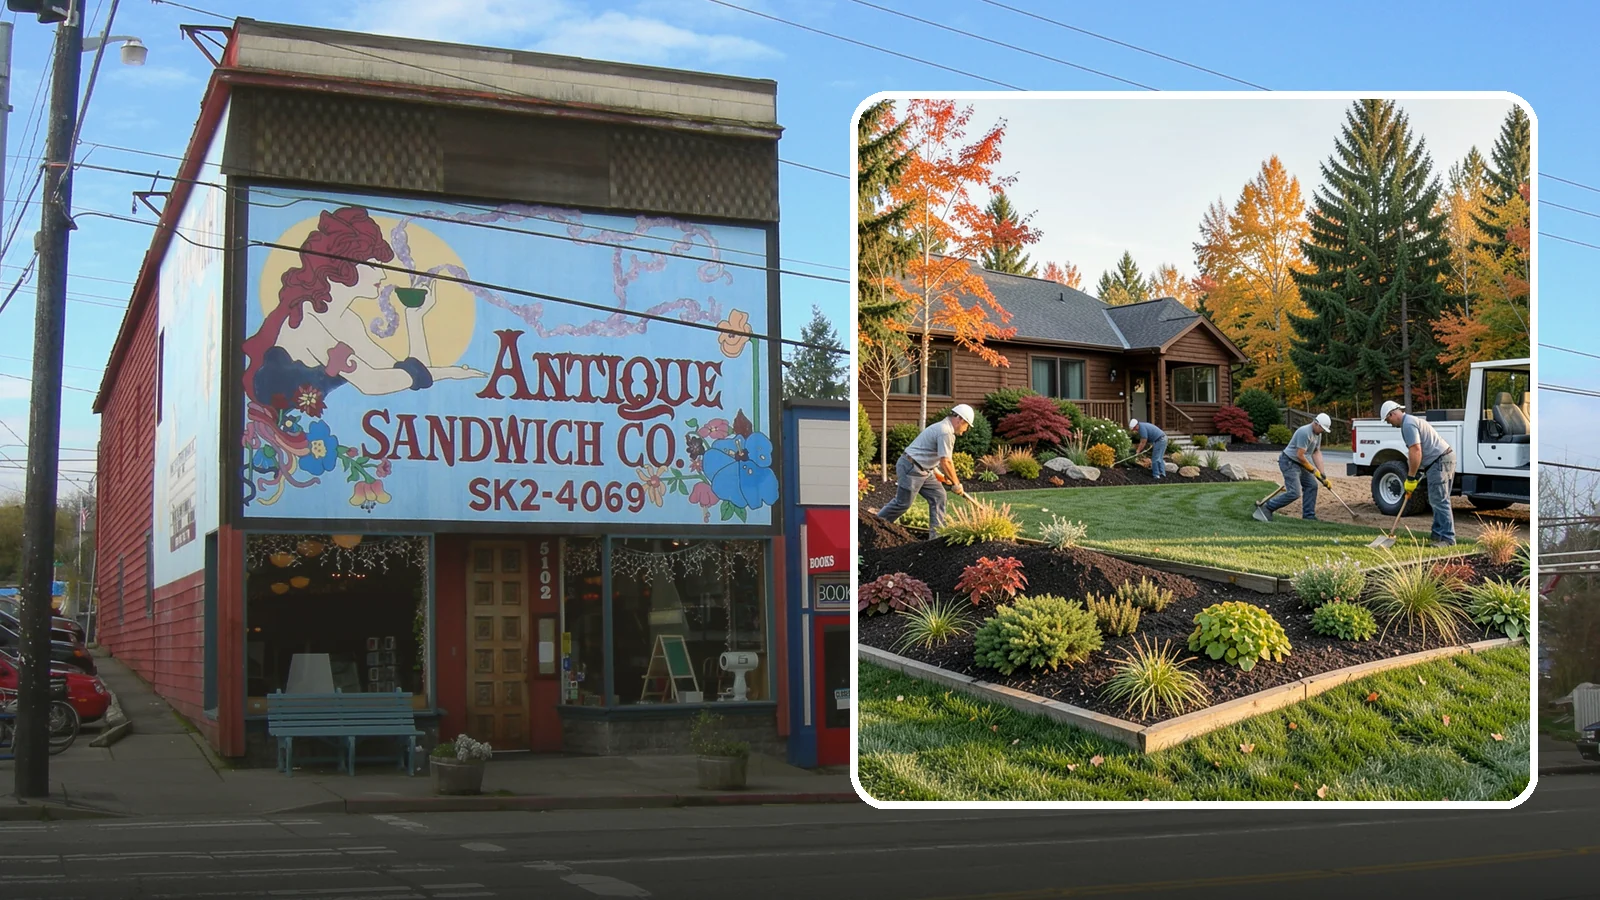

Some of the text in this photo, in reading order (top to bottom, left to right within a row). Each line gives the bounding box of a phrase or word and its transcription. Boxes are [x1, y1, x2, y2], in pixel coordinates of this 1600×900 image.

[475, 328, 724, 421] ANTIQUE
[361, 408, 686, 469] SANDWICH CO.
[468, 476, 646, 514] SK2-4069
[540, 541, 551, 600] 5102
[809, 555, 835, 569] BOOKS
